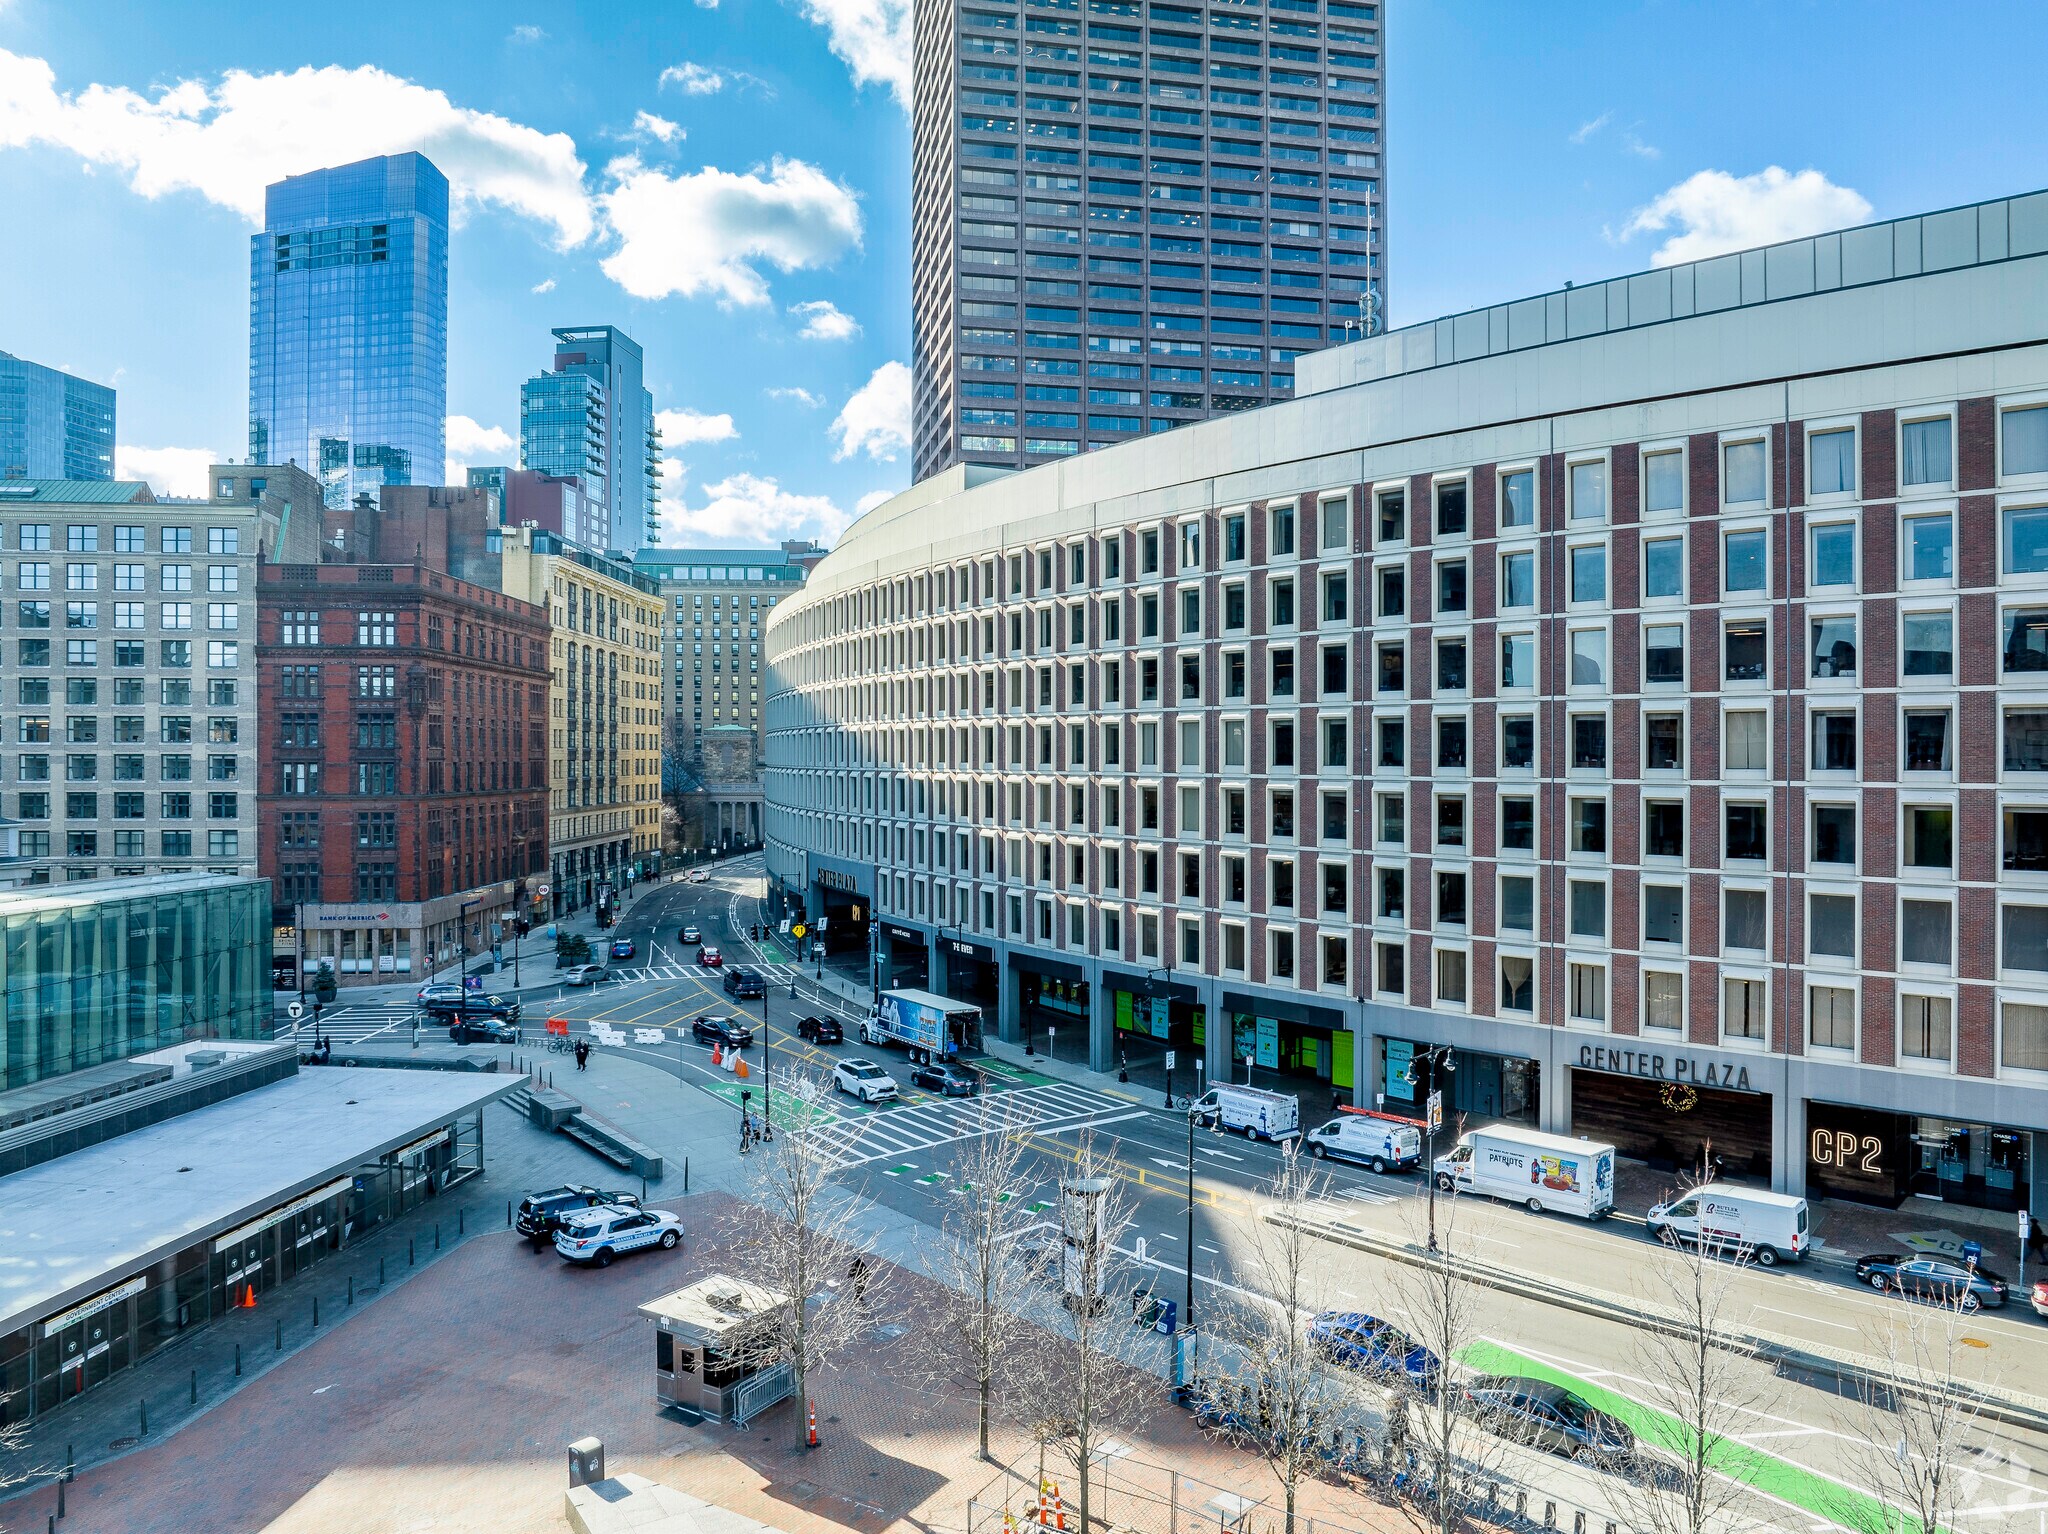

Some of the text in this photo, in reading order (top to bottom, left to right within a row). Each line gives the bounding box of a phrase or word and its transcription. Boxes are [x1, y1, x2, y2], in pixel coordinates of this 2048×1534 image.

[1580, 1046, 1751, 1090] CENTER PLAZA
[1489, 1153, 1523, 1168] PATRIOTS
[1812, 1128, 1882, 1173] CP2
[65, 1298, 103, 1321] GOVERNMENT
[104, 1288, 126, 1302] CENTER
